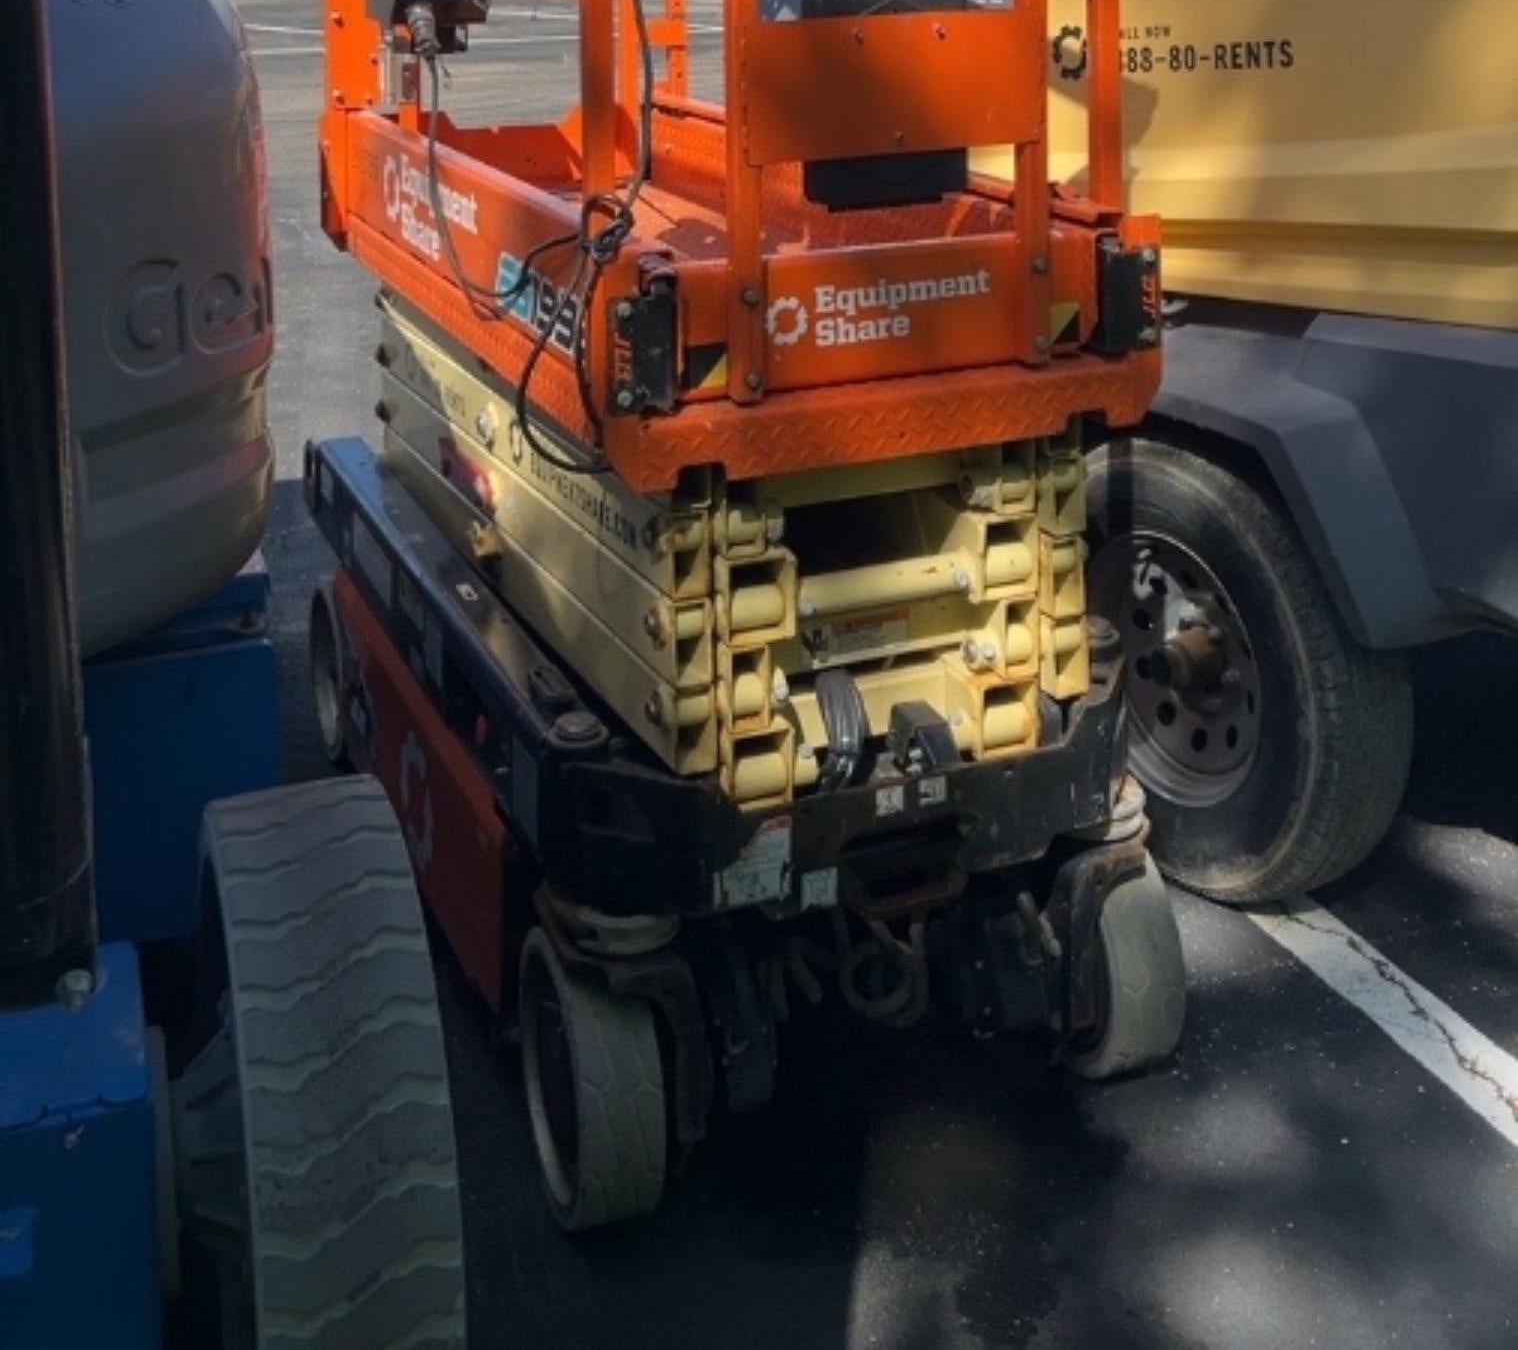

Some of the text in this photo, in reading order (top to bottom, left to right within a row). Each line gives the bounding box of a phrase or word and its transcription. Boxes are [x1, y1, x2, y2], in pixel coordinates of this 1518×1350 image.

[1118, 40, 1294, 74] 88-80-RENTS
[814, 269, 991, 315] Equipment
[815, 314, 911, 347] Share
